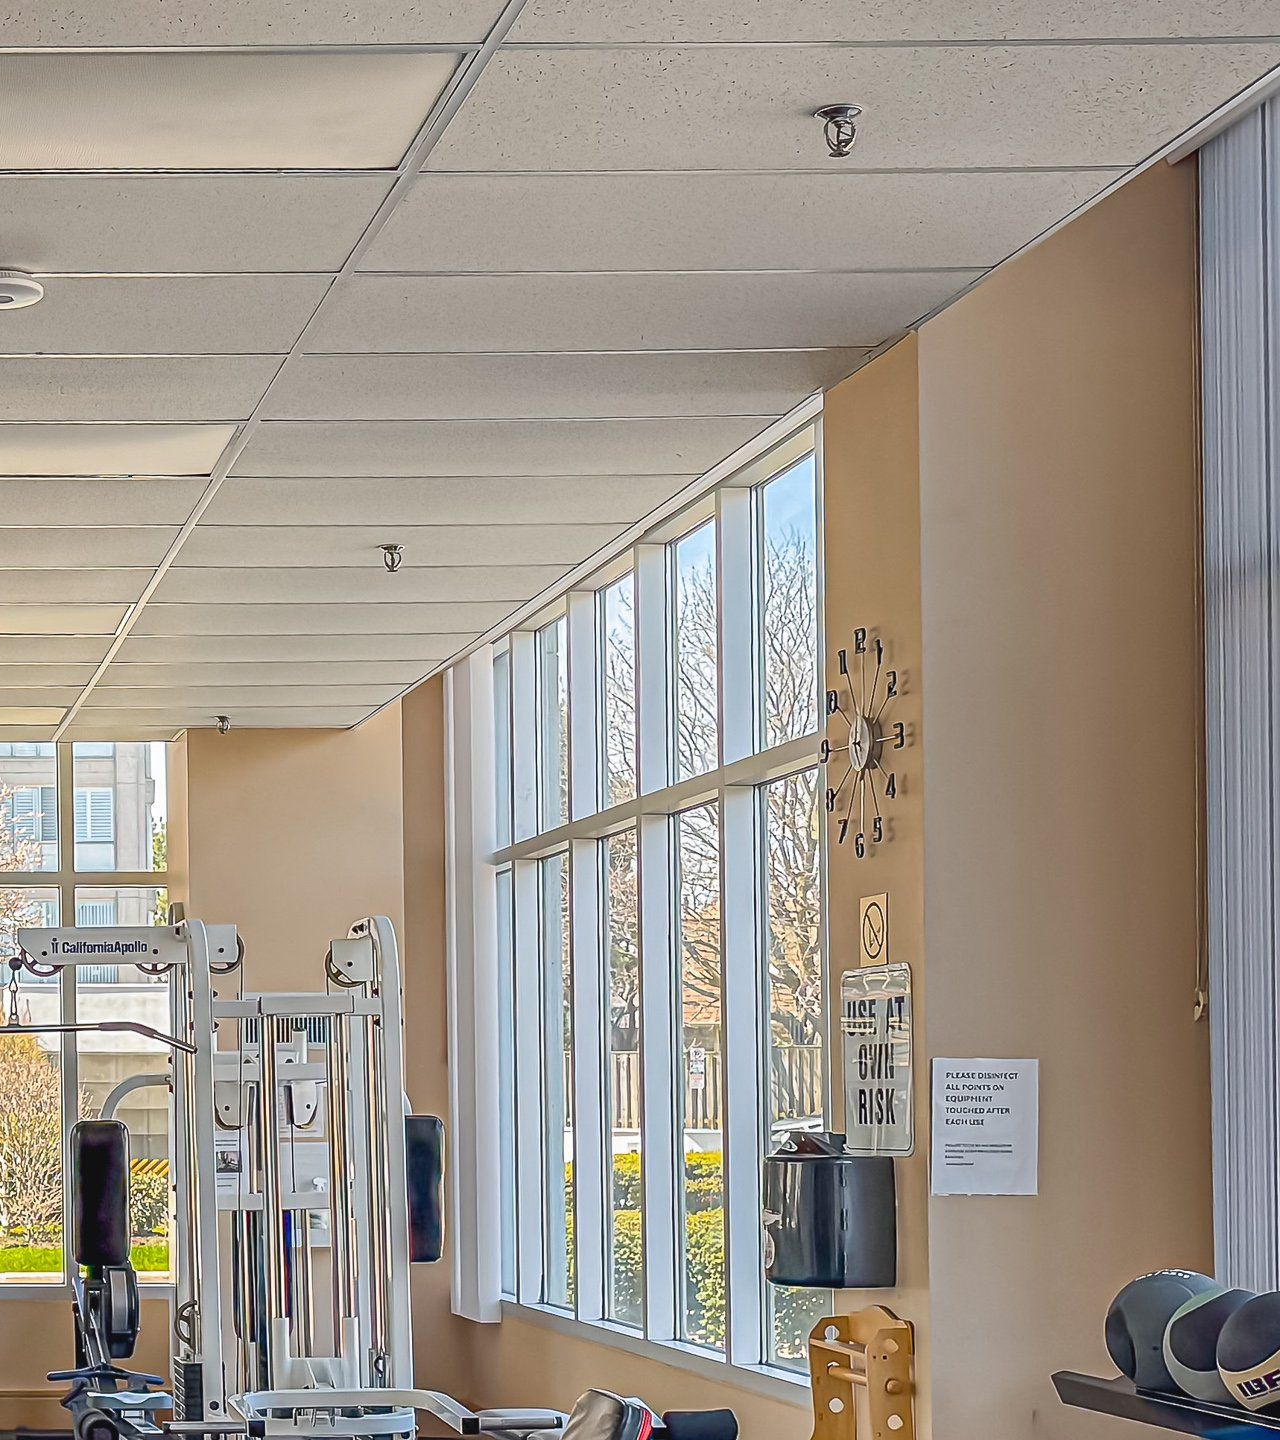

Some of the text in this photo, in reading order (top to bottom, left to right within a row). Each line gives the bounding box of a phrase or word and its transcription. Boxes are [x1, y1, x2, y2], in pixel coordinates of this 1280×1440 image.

[886, 670, 897, 698] 2
[892, 722, 905, 749] 3
[820, 739, 830, 764] 9
[885, 772, 896, 799] 4
[838, 819, 849, 844] 7
[873, 816, 882, 843] 5
[855, 833, 865, 858] 6
[847, 996, 905, 1036] USE AT
[858, 1043, 895, 1080] OWN
[977, 1072, 1019, 1080] DISINFECT
[858, 1088, 896, 1125] RISK
[945, 1095, 993, 1103] EQUIPMENT
